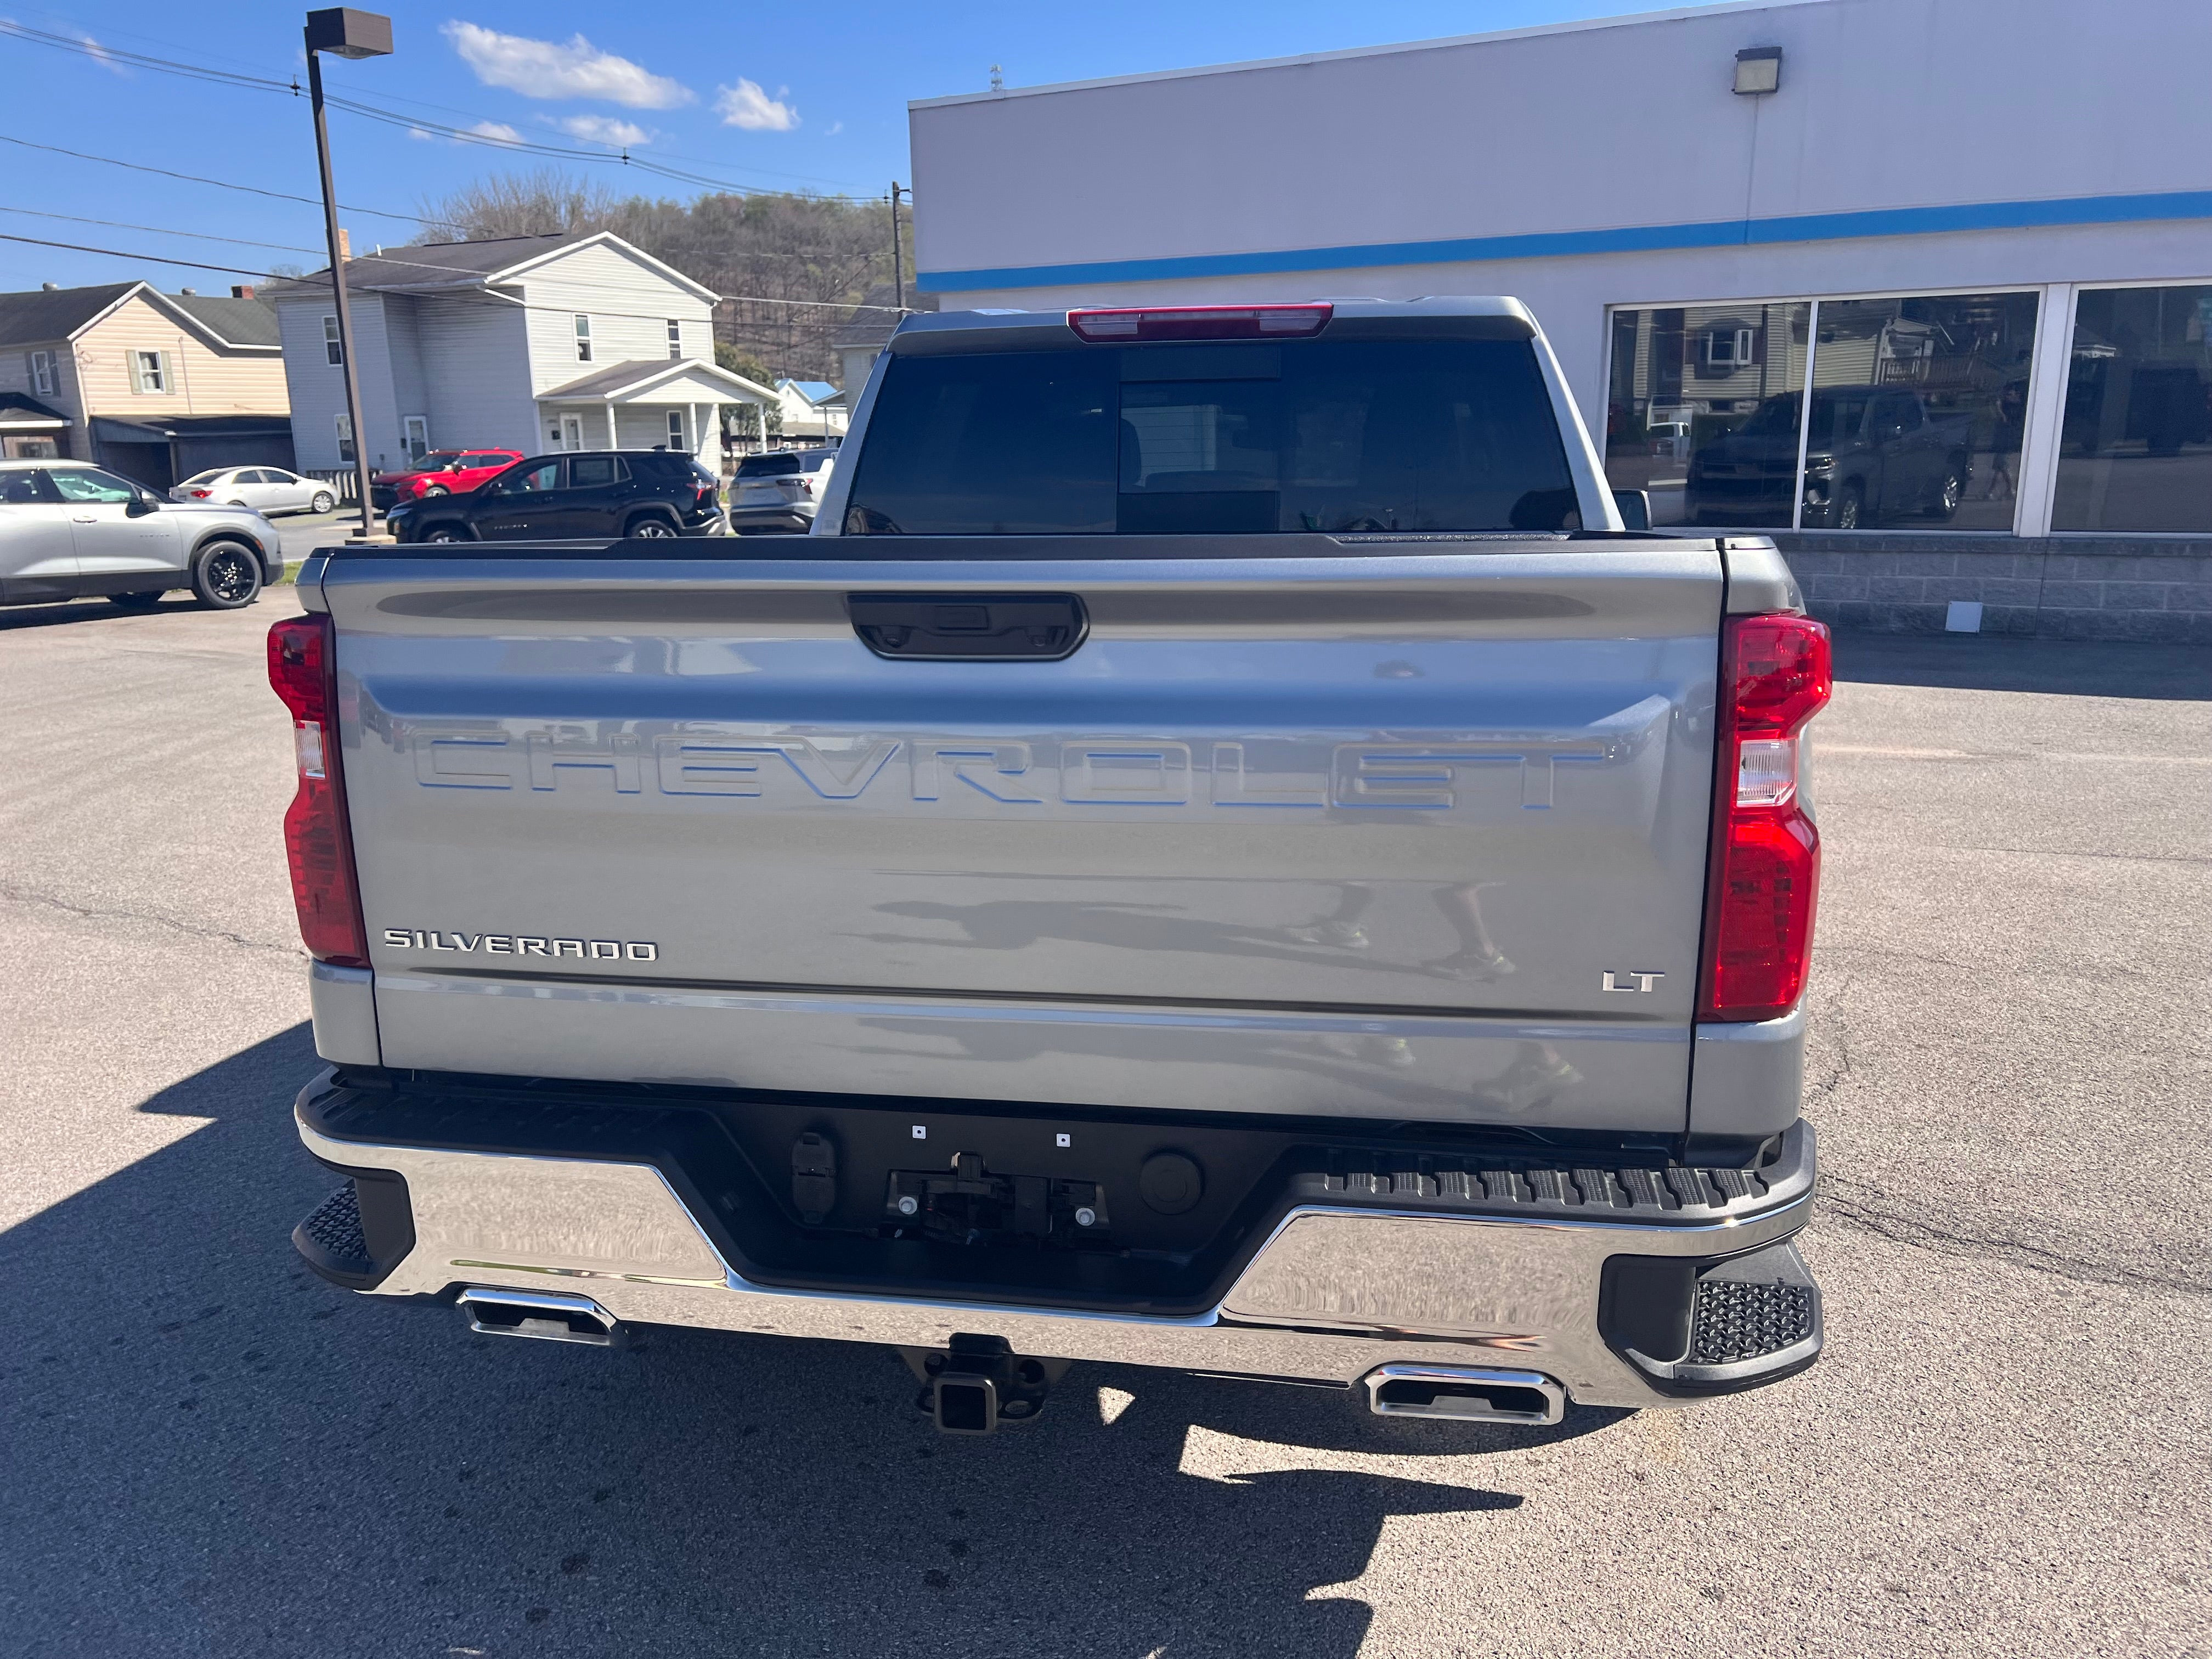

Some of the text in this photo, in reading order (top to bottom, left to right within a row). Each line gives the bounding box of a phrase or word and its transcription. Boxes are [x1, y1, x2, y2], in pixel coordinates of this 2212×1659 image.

[412, 729, 1605, 810] CHEVROLET
[383, 928, 658, 961] SILVERADO
[1602, 970, 1665, 992] LT
